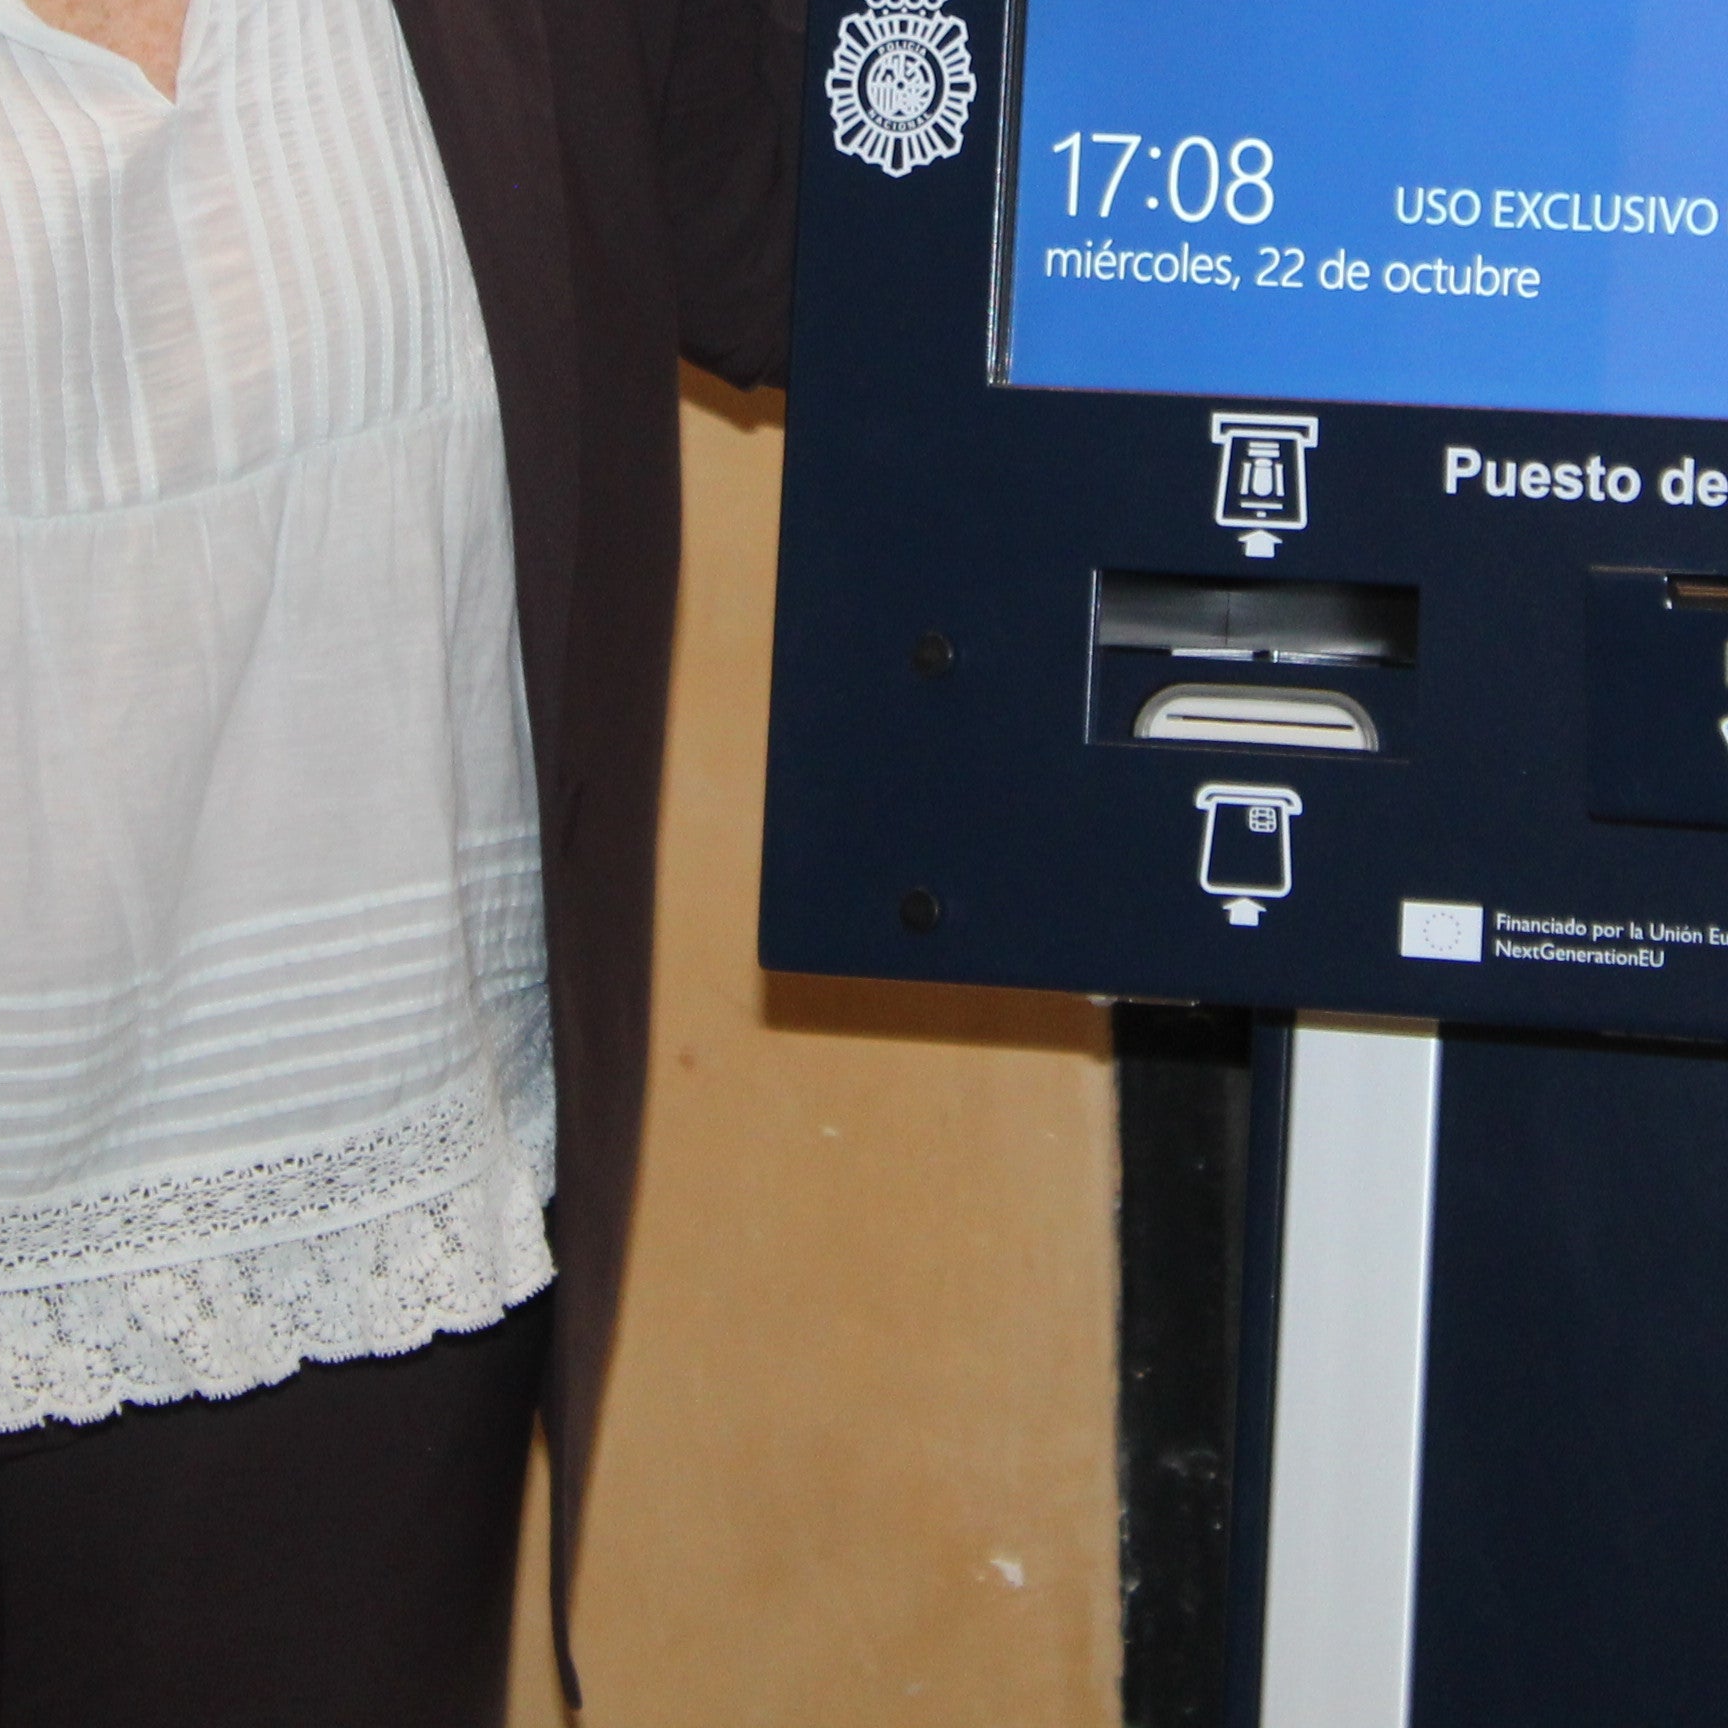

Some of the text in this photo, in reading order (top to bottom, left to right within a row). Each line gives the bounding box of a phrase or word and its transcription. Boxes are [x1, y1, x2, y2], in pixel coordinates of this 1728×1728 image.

[867, 109, 935, 132] NACIONAL
[1052, 131, 1274, 225] 17:08
[1396, 186, 1482, 226] USO
[1492, 190, 1719, 236] EXCLUSIVO
[1045, 239, 1541, 299] miércoles, 22 de octubre
[1445, 446, 1642, 503] Puesto
[1659, 456, 1728, 507] de
[1496, 912, 1587, 936] Financiado
[1591, 923, 1625, 942] por
[1629, 921, 1644, 940] la
[1649, 922, 1703, 944] Unión
[1494, 939, 1665, 968] NextGenerationEU
